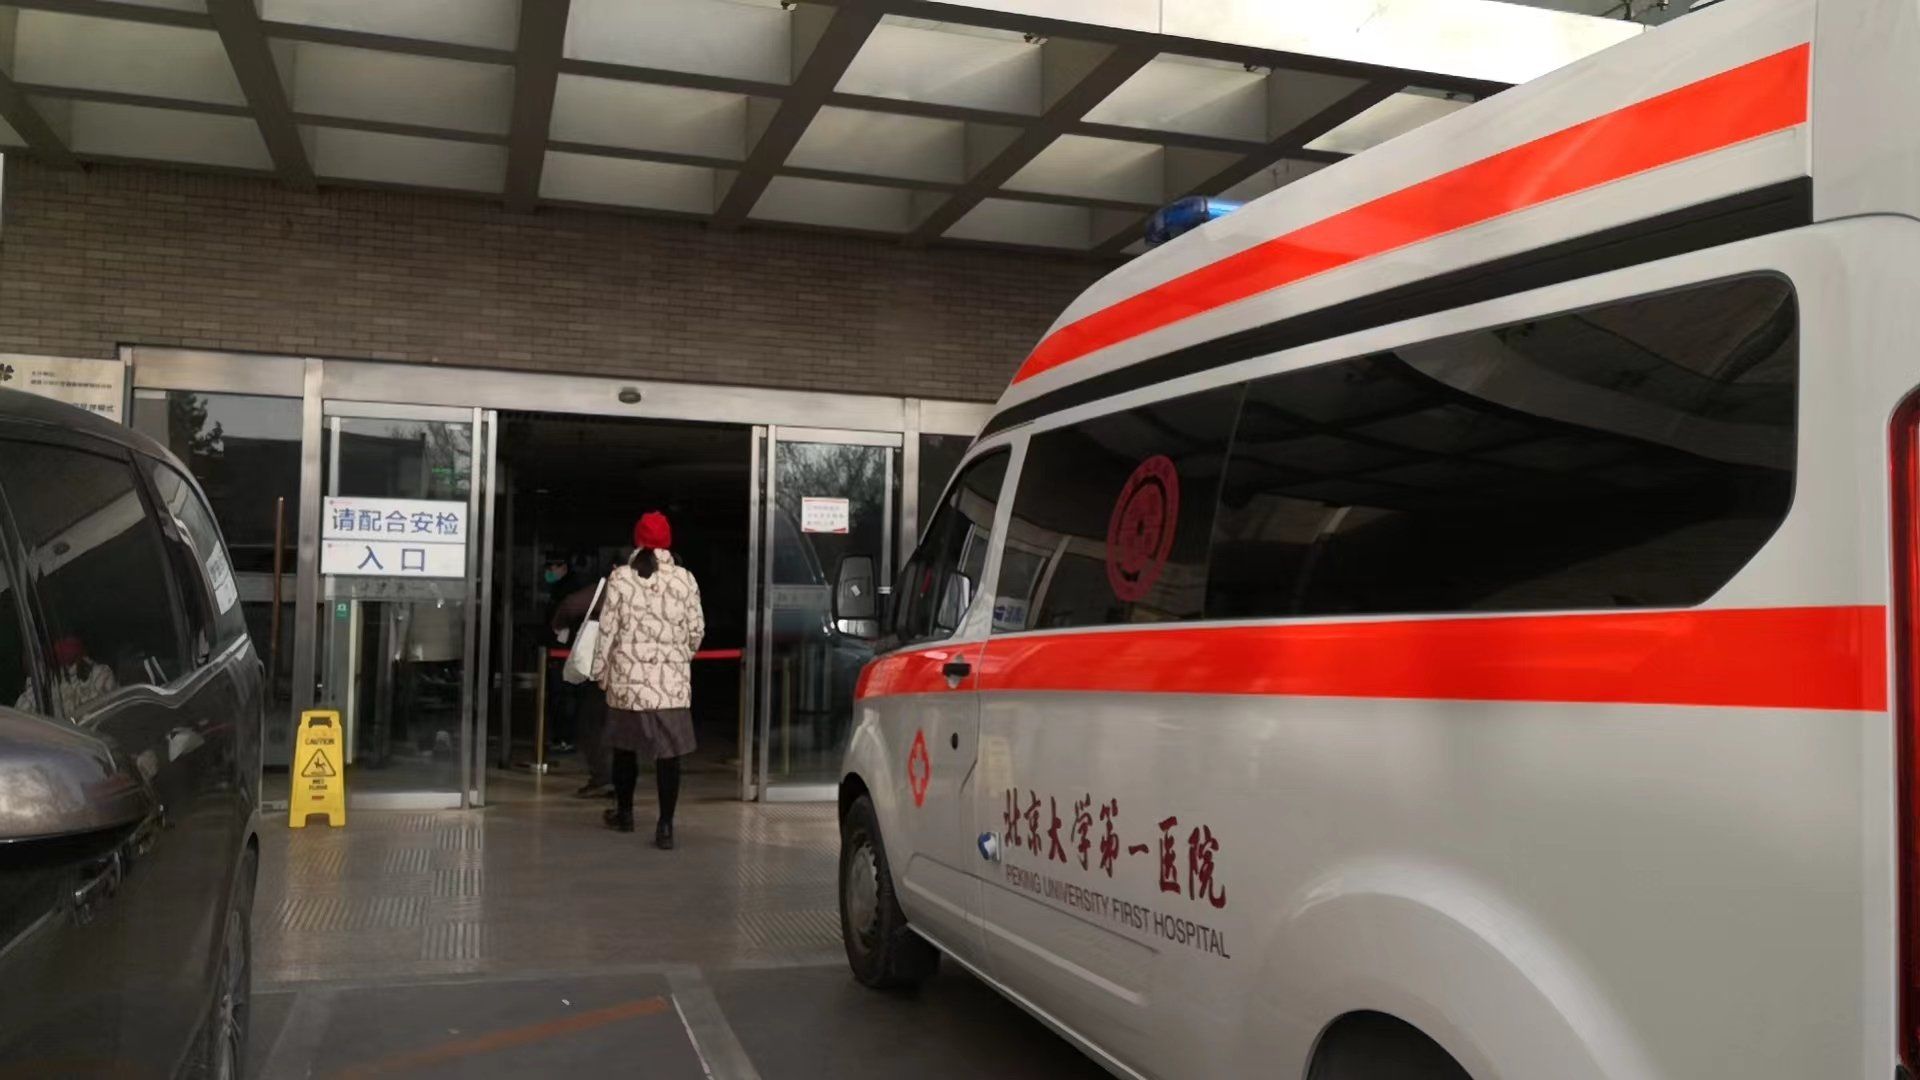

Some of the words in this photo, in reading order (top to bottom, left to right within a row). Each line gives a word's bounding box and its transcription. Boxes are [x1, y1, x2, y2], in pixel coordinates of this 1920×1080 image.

[332, 507, 459, 535] 请配合安检
[357, 545, 426, 572] 入口
[1003, 787, 1227, 909] 北京大学第一医院
[1006, 863, 1042, 895] PEKING
[1042, 875, 1110, 917] UNIVERSITY
[1111, 897, 1151, 934] FIRST
[1153, 911, 1231, 959] HOSPITAL
